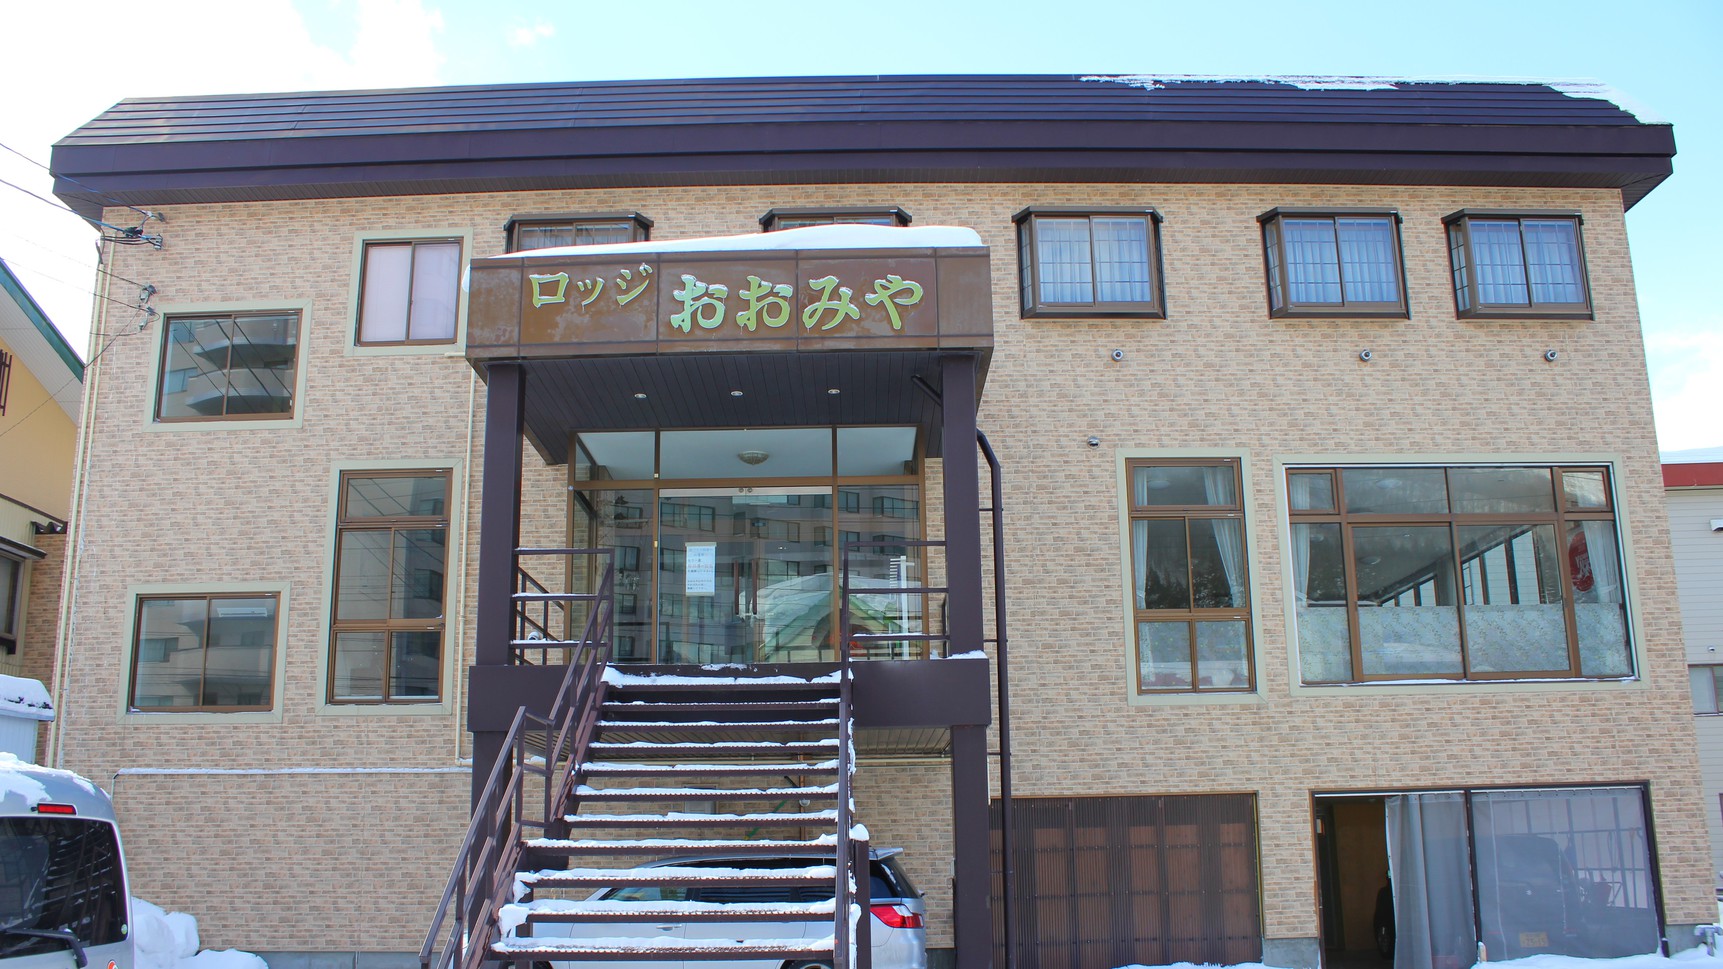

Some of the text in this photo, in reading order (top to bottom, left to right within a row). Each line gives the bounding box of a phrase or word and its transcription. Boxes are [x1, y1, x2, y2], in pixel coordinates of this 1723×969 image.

[529, 262, 924, 332] ロッジ おおみや
